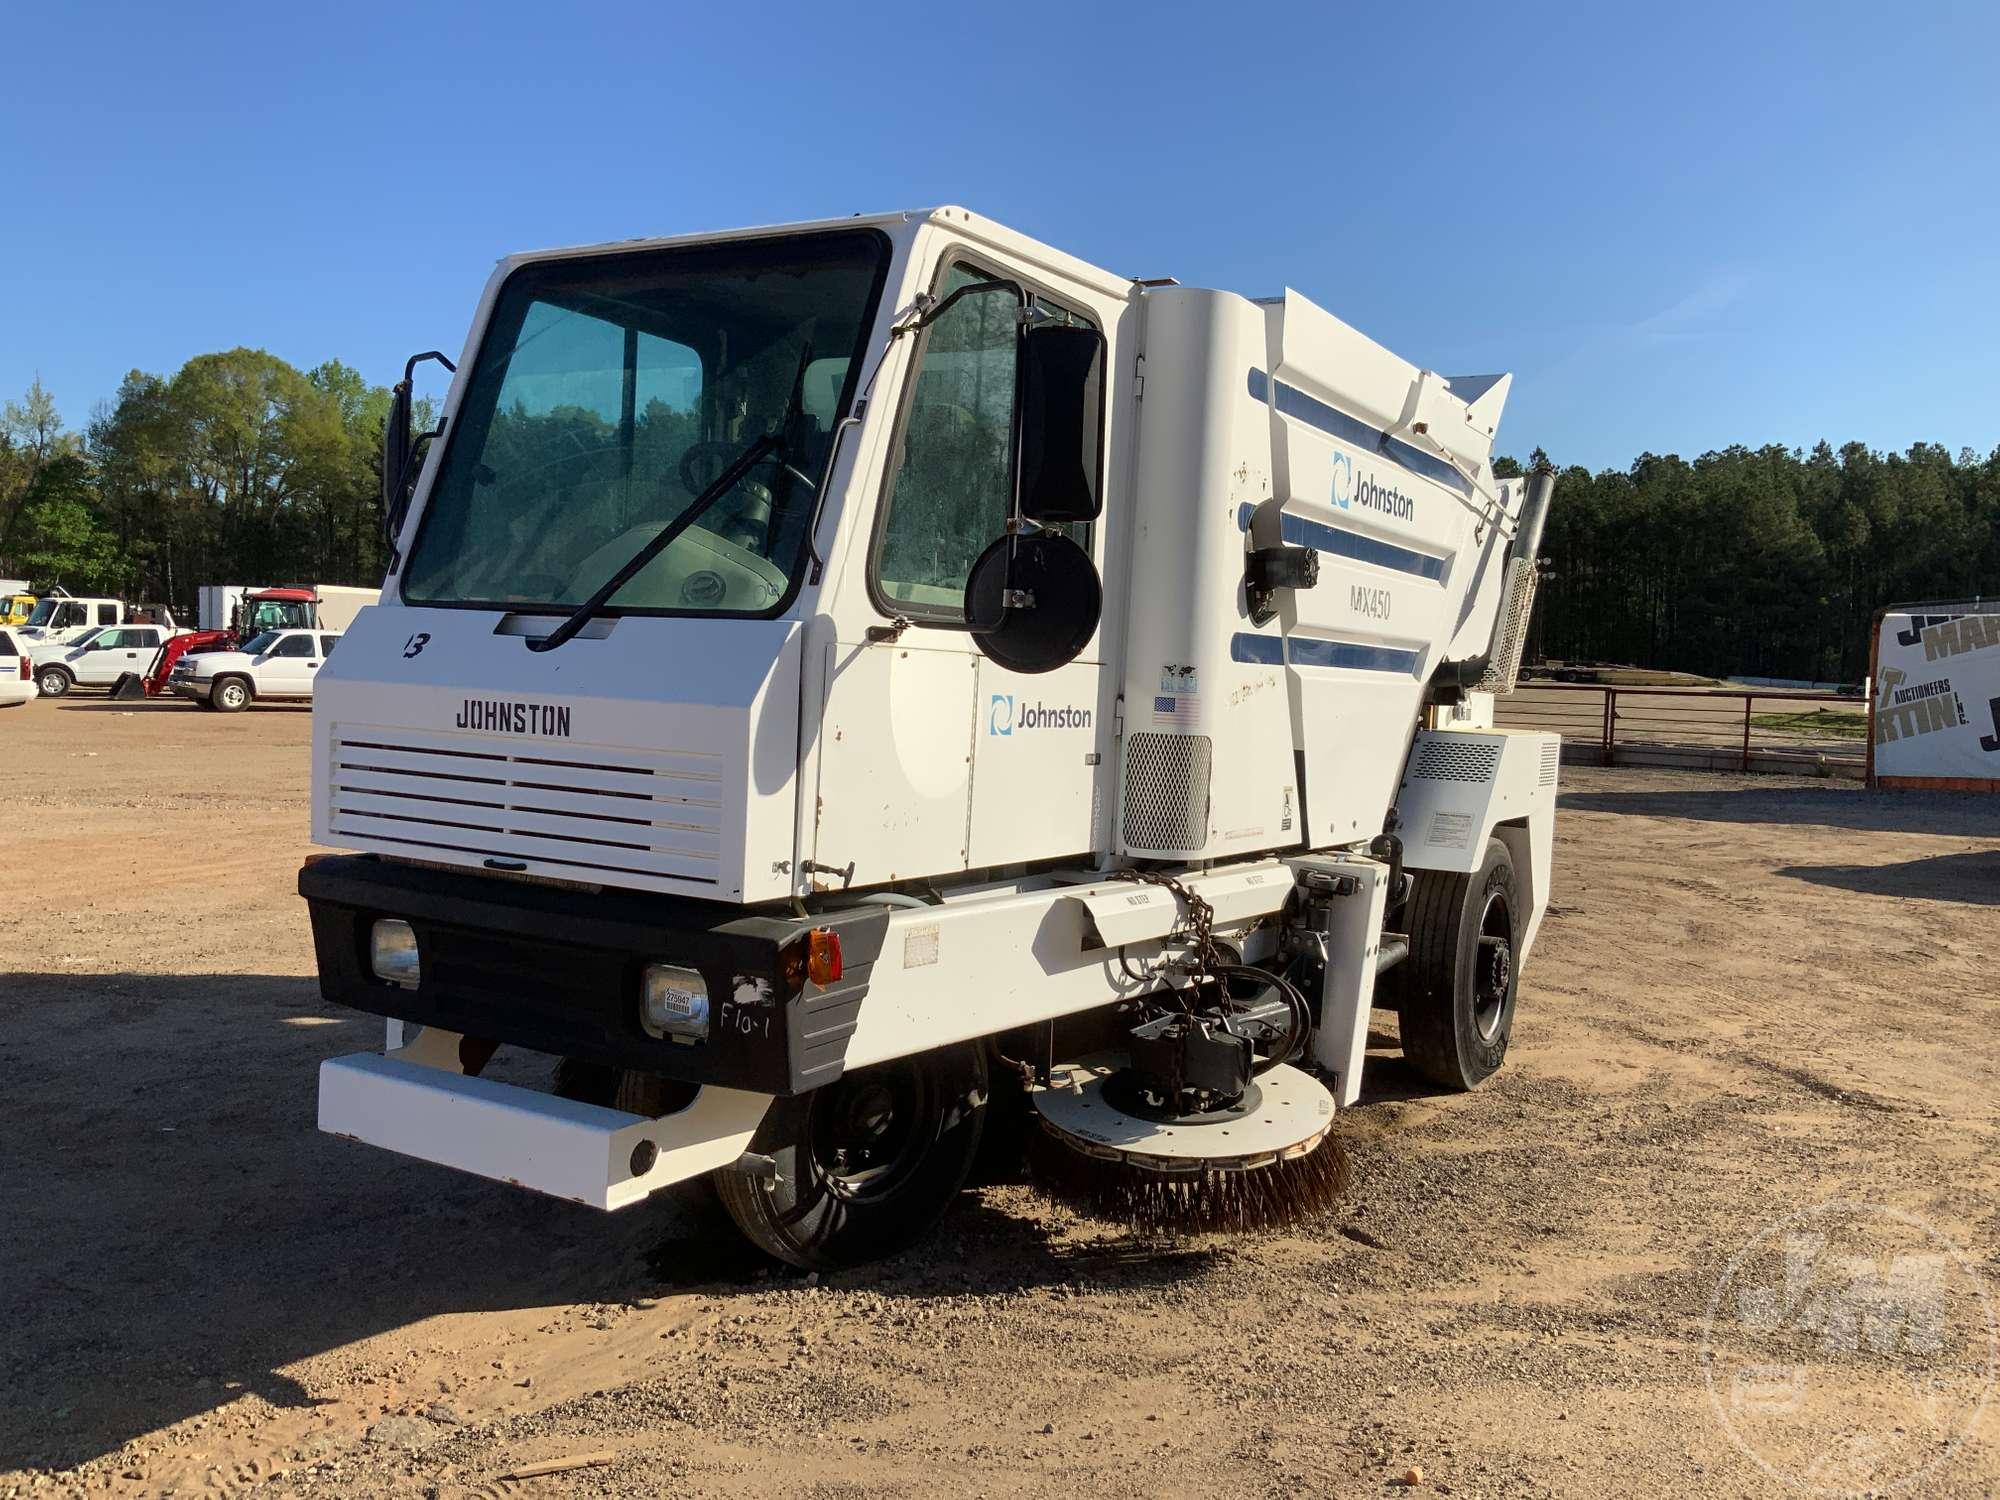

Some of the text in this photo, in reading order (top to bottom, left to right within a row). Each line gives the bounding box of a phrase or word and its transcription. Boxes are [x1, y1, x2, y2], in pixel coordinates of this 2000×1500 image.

[1353, 470, 1414, 522] Johnston
[1350, 584, 1391, 620] MX450
[1894, 678, 1951, 705] AUCTIONEERS
[456, 698, 570, 738] JOHNSTON
[1018, 701, 1092, 729] Johnston
